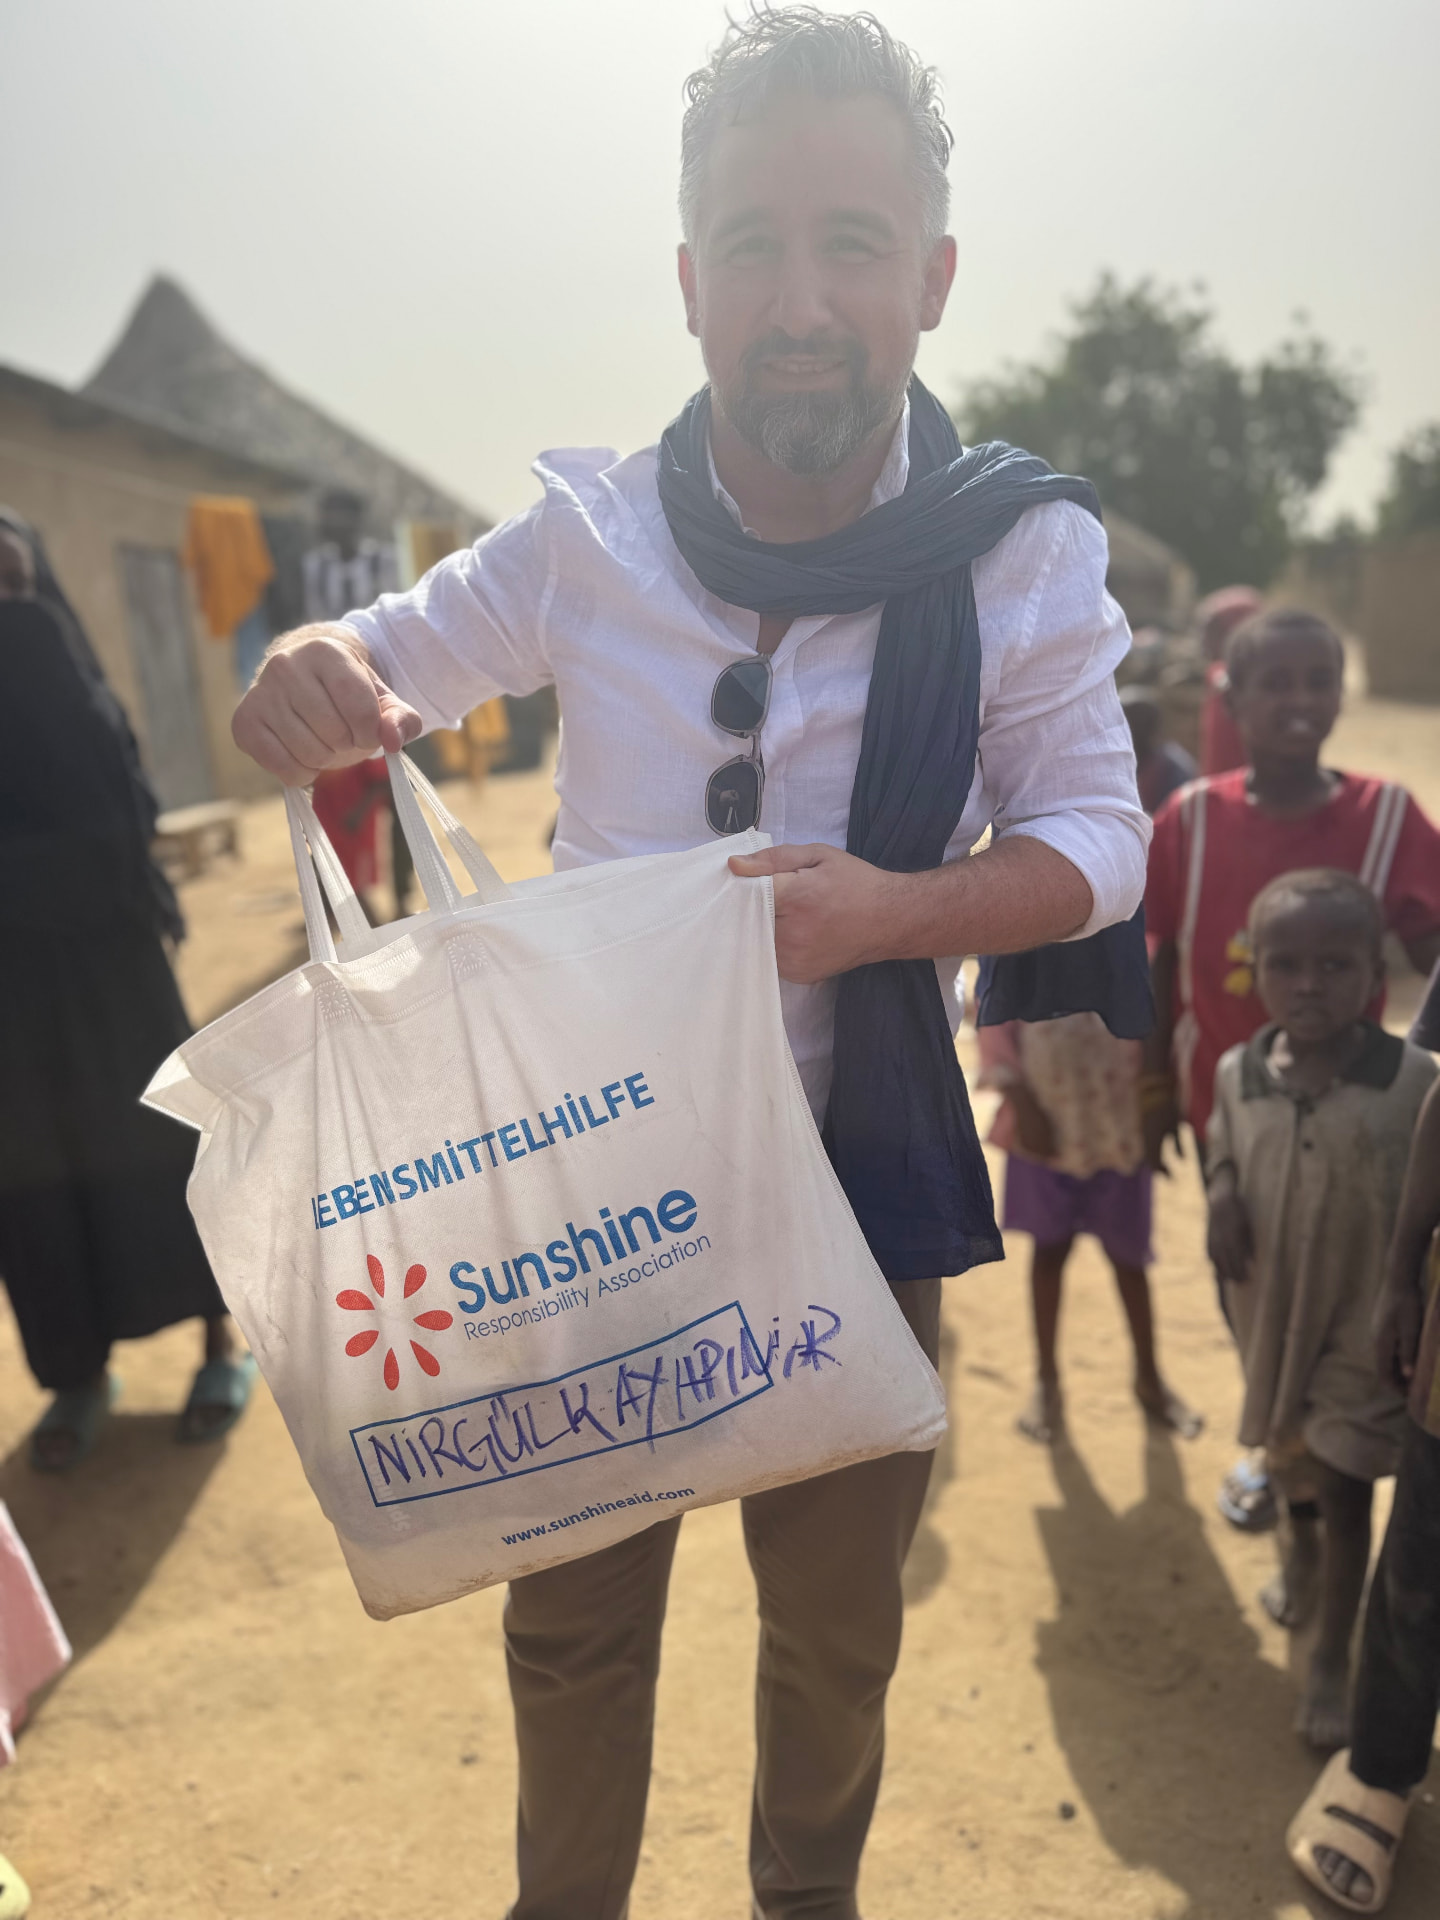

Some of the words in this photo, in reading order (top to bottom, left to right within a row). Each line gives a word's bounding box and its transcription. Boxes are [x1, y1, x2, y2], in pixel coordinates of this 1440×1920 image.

[449, 1189, 698, 1314] Sunshine
[463, 1287, 589, 1341] Responsibility
[598, 1235, 712, 1298] Association
[500, 1487, 696, 1545] www.sunshineaid.com
